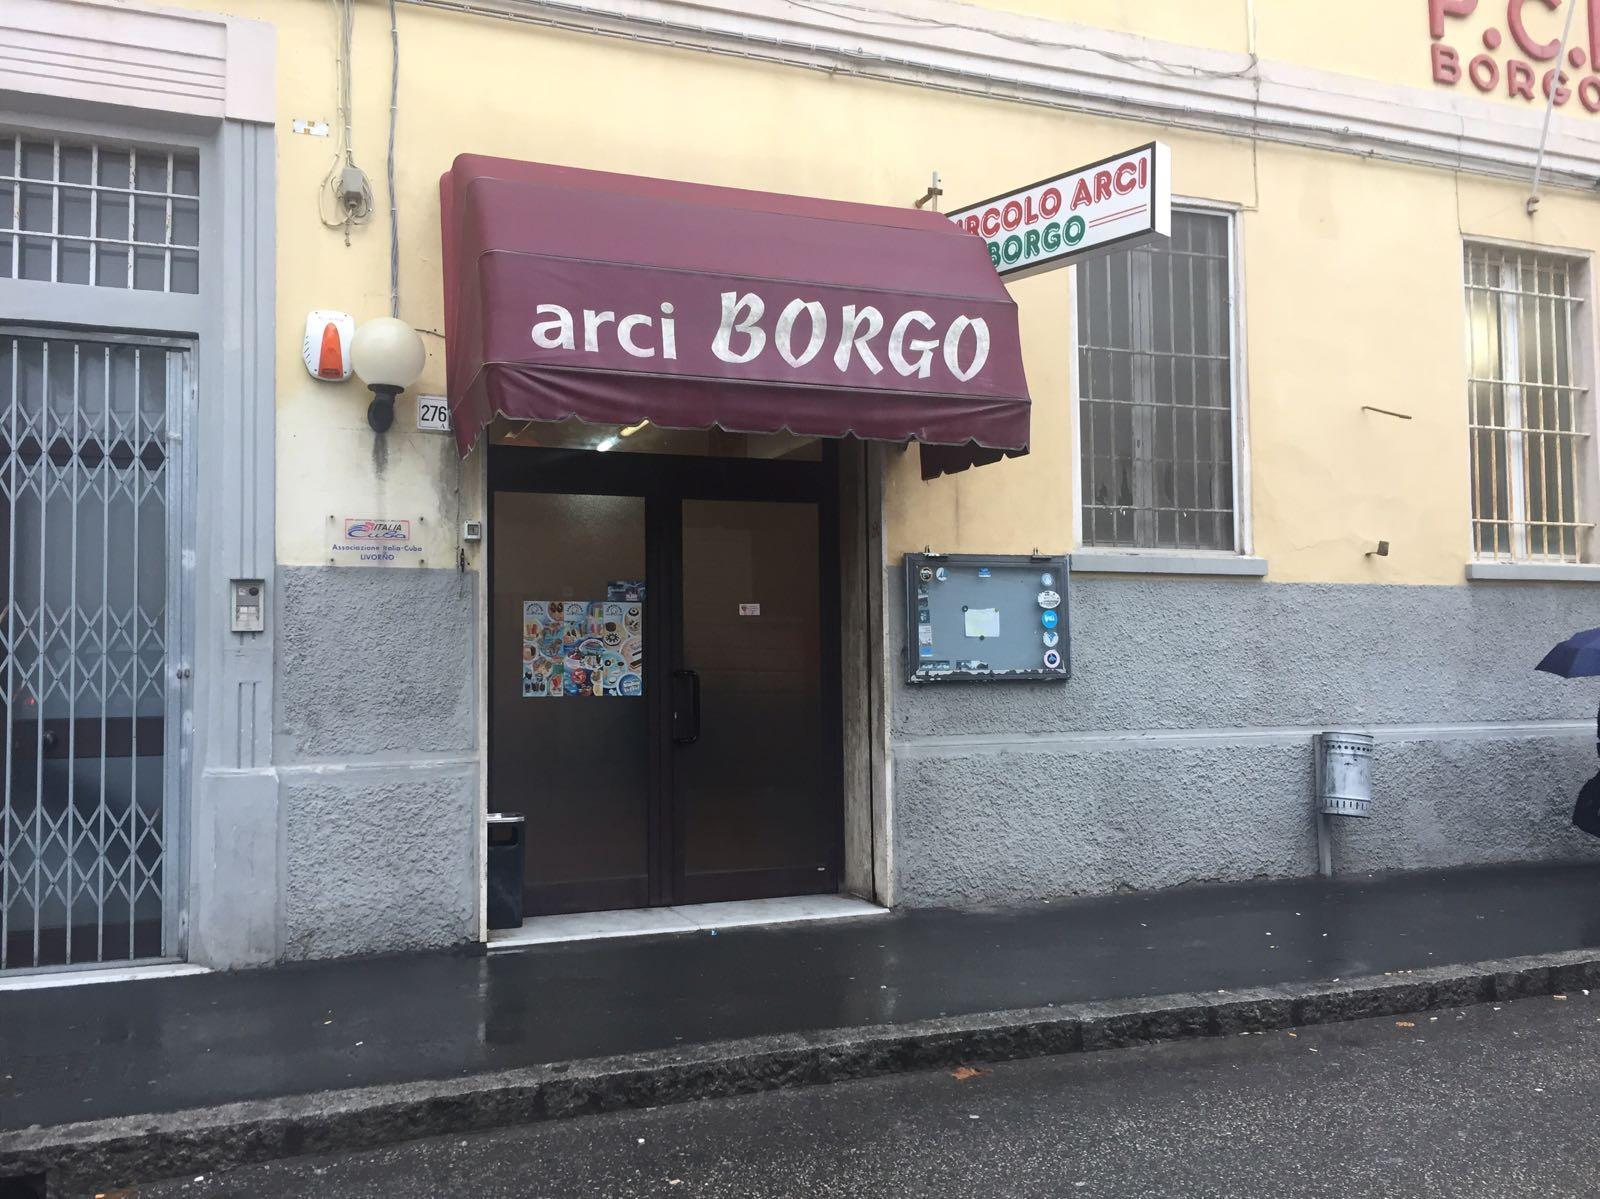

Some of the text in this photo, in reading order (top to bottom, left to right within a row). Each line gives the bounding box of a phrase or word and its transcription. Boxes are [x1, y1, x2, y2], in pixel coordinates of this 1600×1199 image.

[1431, 43, 1600, 112] BORGO
[1070, 157, 1147, 211] ARCI
[987, 215, 1086, 268] BORGO
[531, 291, 991, 382] arci BORGO
[421, 405, 447, 422] 276
[373, 523, 402, 531] ITALIA
